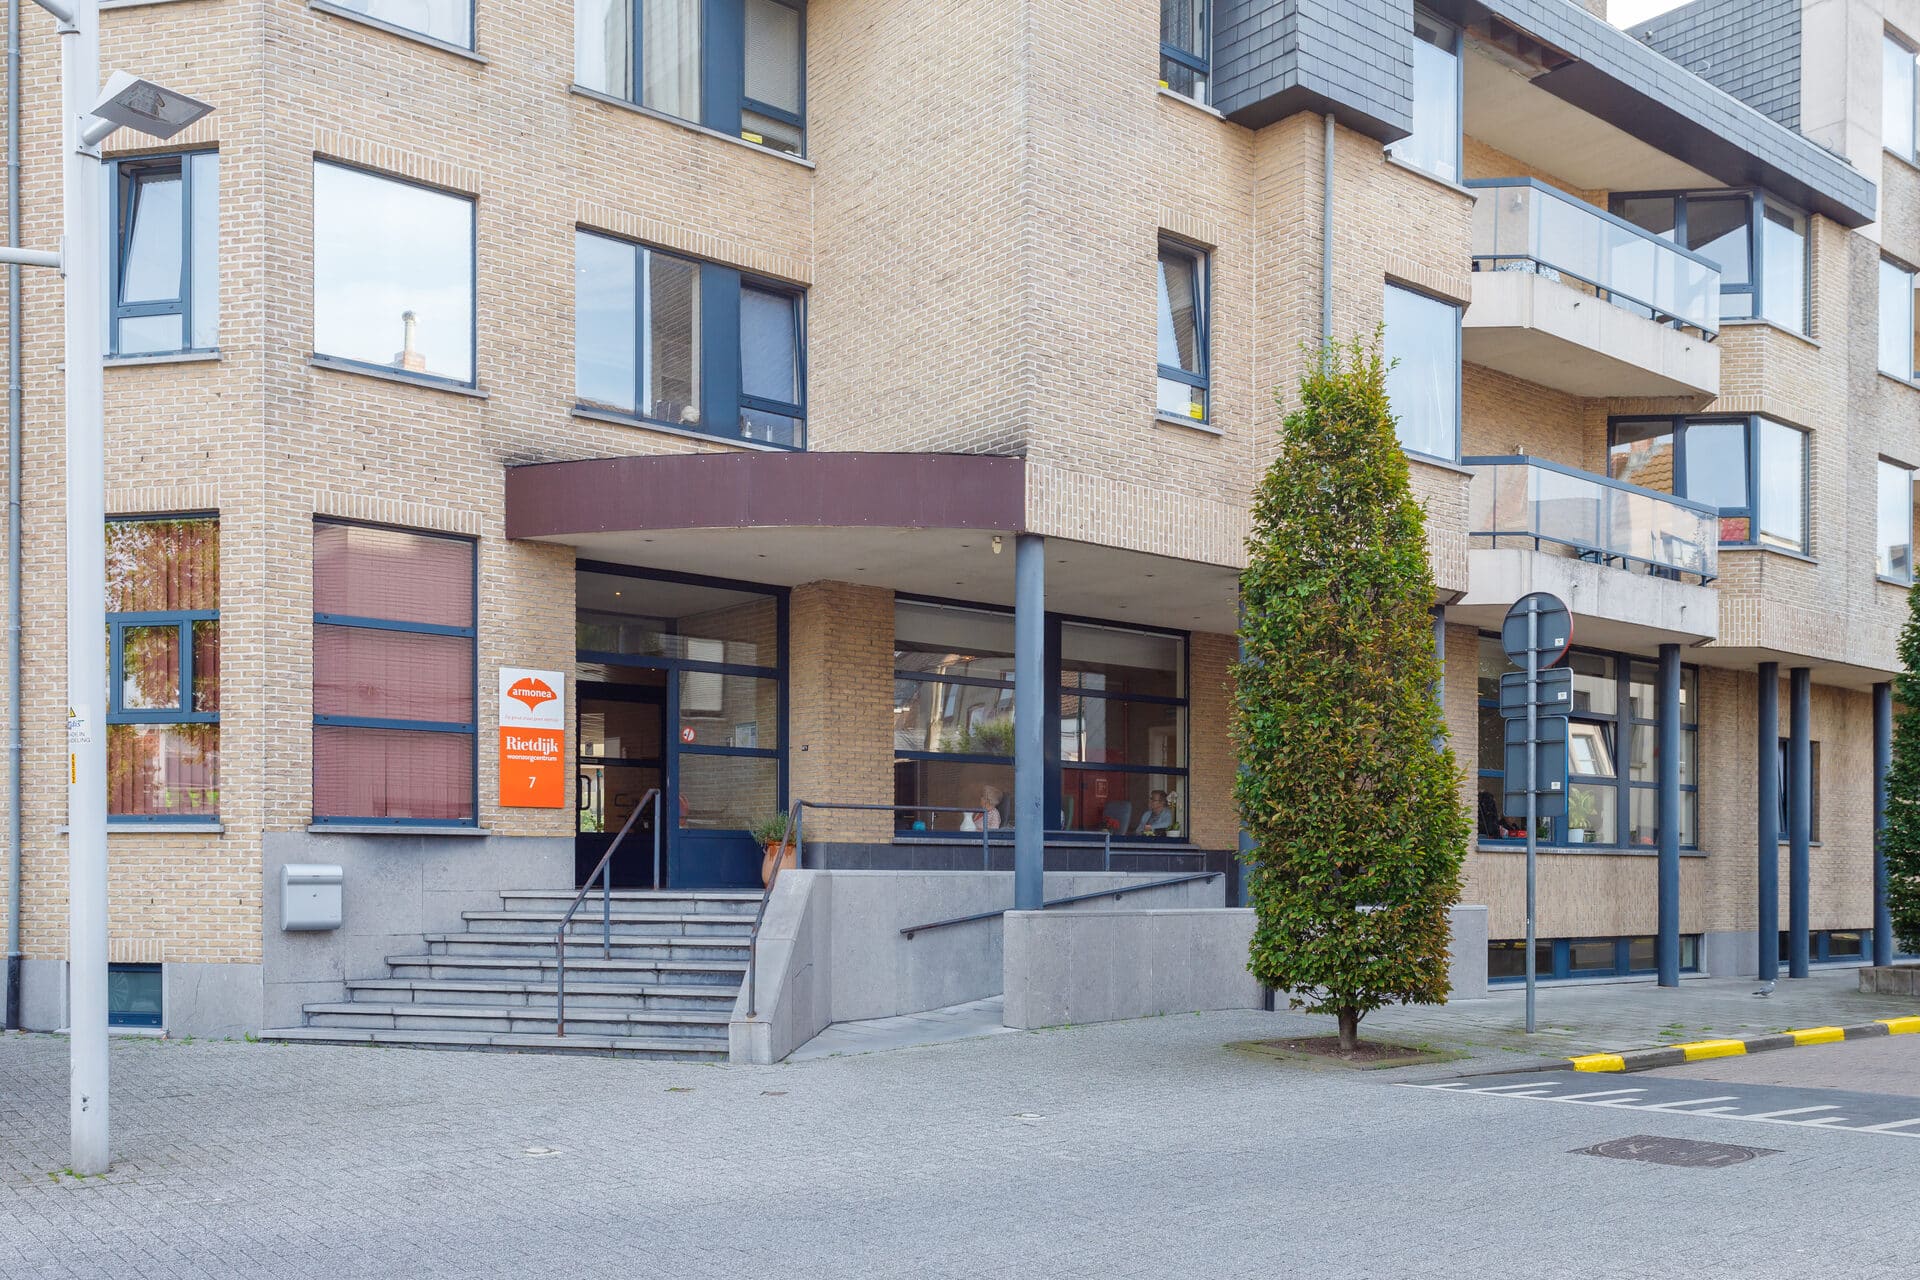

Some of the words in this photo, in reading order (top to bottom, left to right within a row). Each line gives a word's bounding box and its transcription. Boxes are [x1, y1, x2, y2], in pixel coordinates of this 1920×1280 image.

[512, 687, 552, 698] armonea
[506, 736, 559, 755] Rietdijk
[506, 754, 558, 763] woonzorgcentrum
[528, 776, 537, 789] 7
